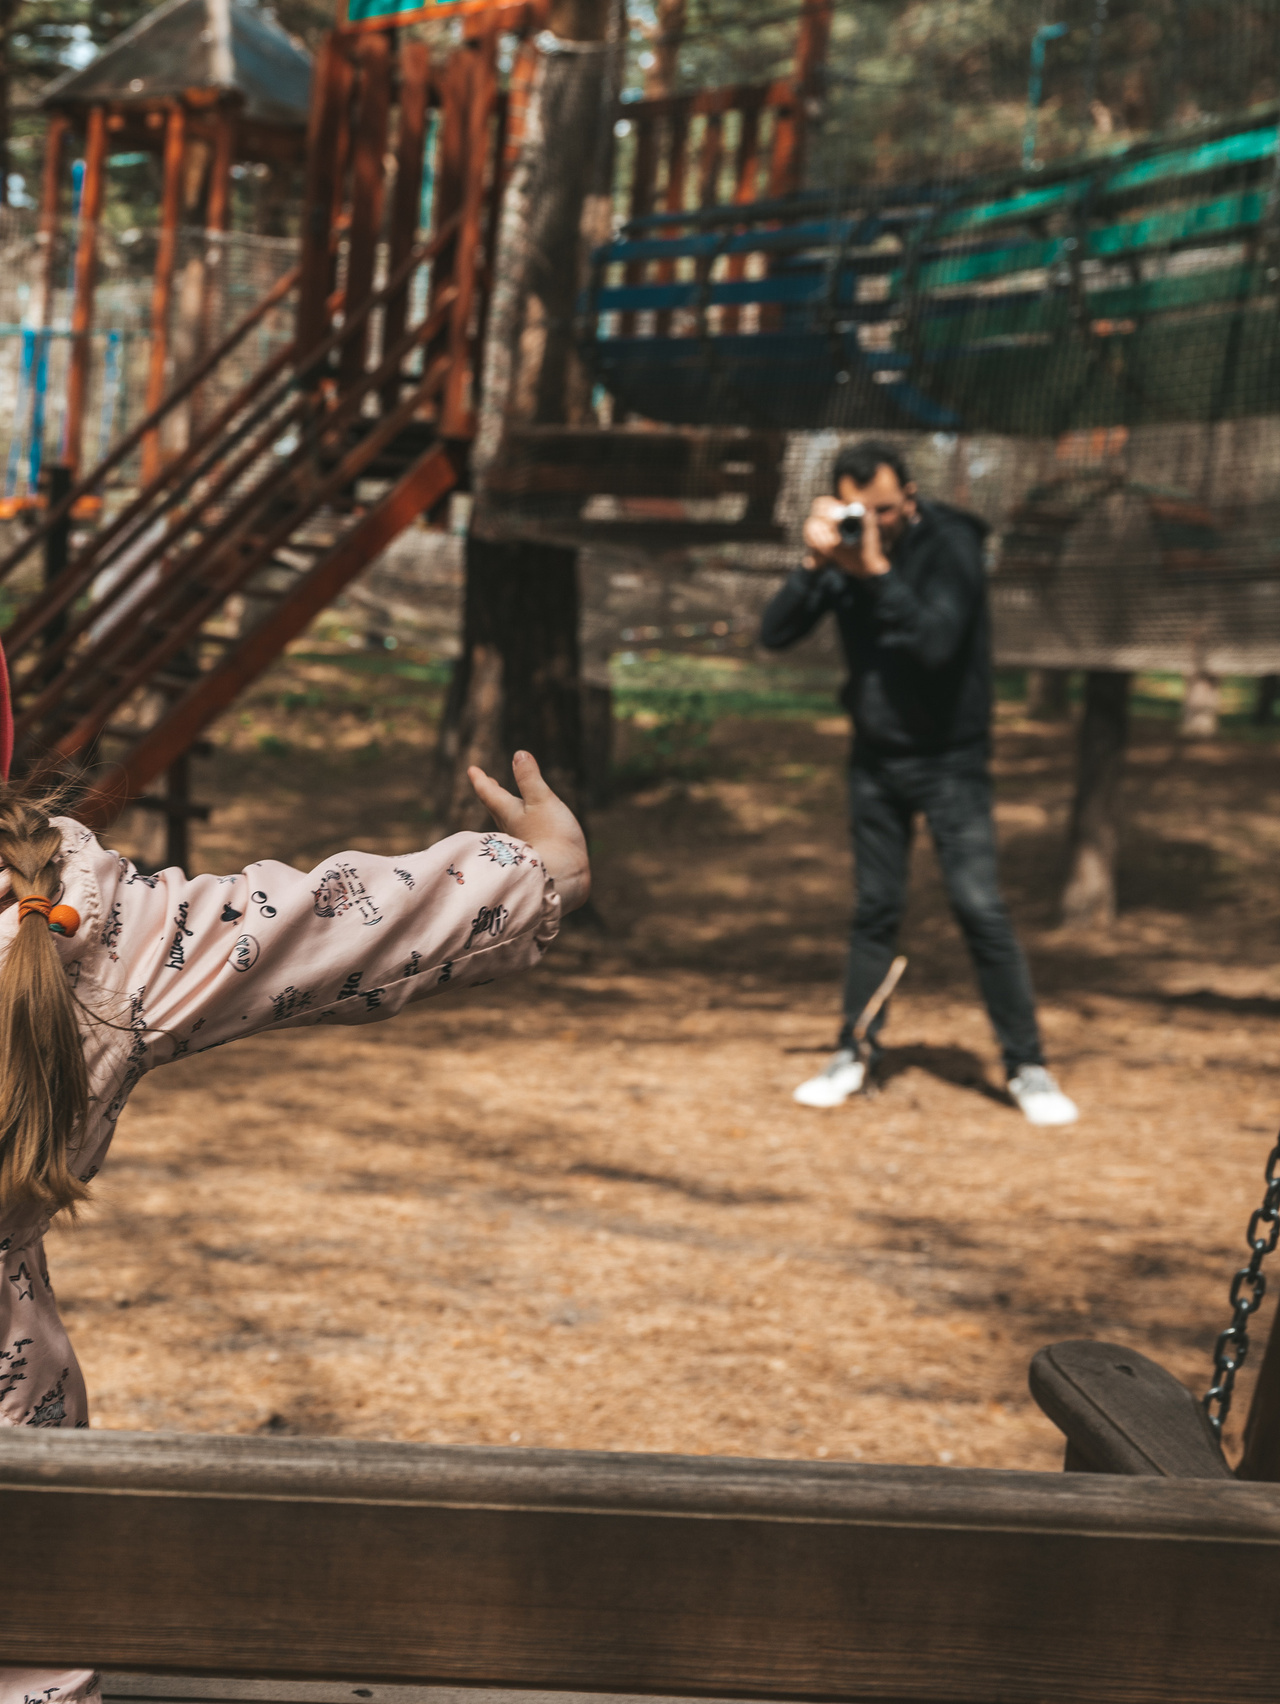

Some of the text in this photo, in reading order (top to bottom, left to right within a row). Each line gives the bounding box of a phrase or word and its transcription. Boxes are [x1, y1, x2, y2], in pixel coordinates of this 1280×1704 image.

[164, 901, 195, 971] have fun
[236, 937, 250, 968] YAY
